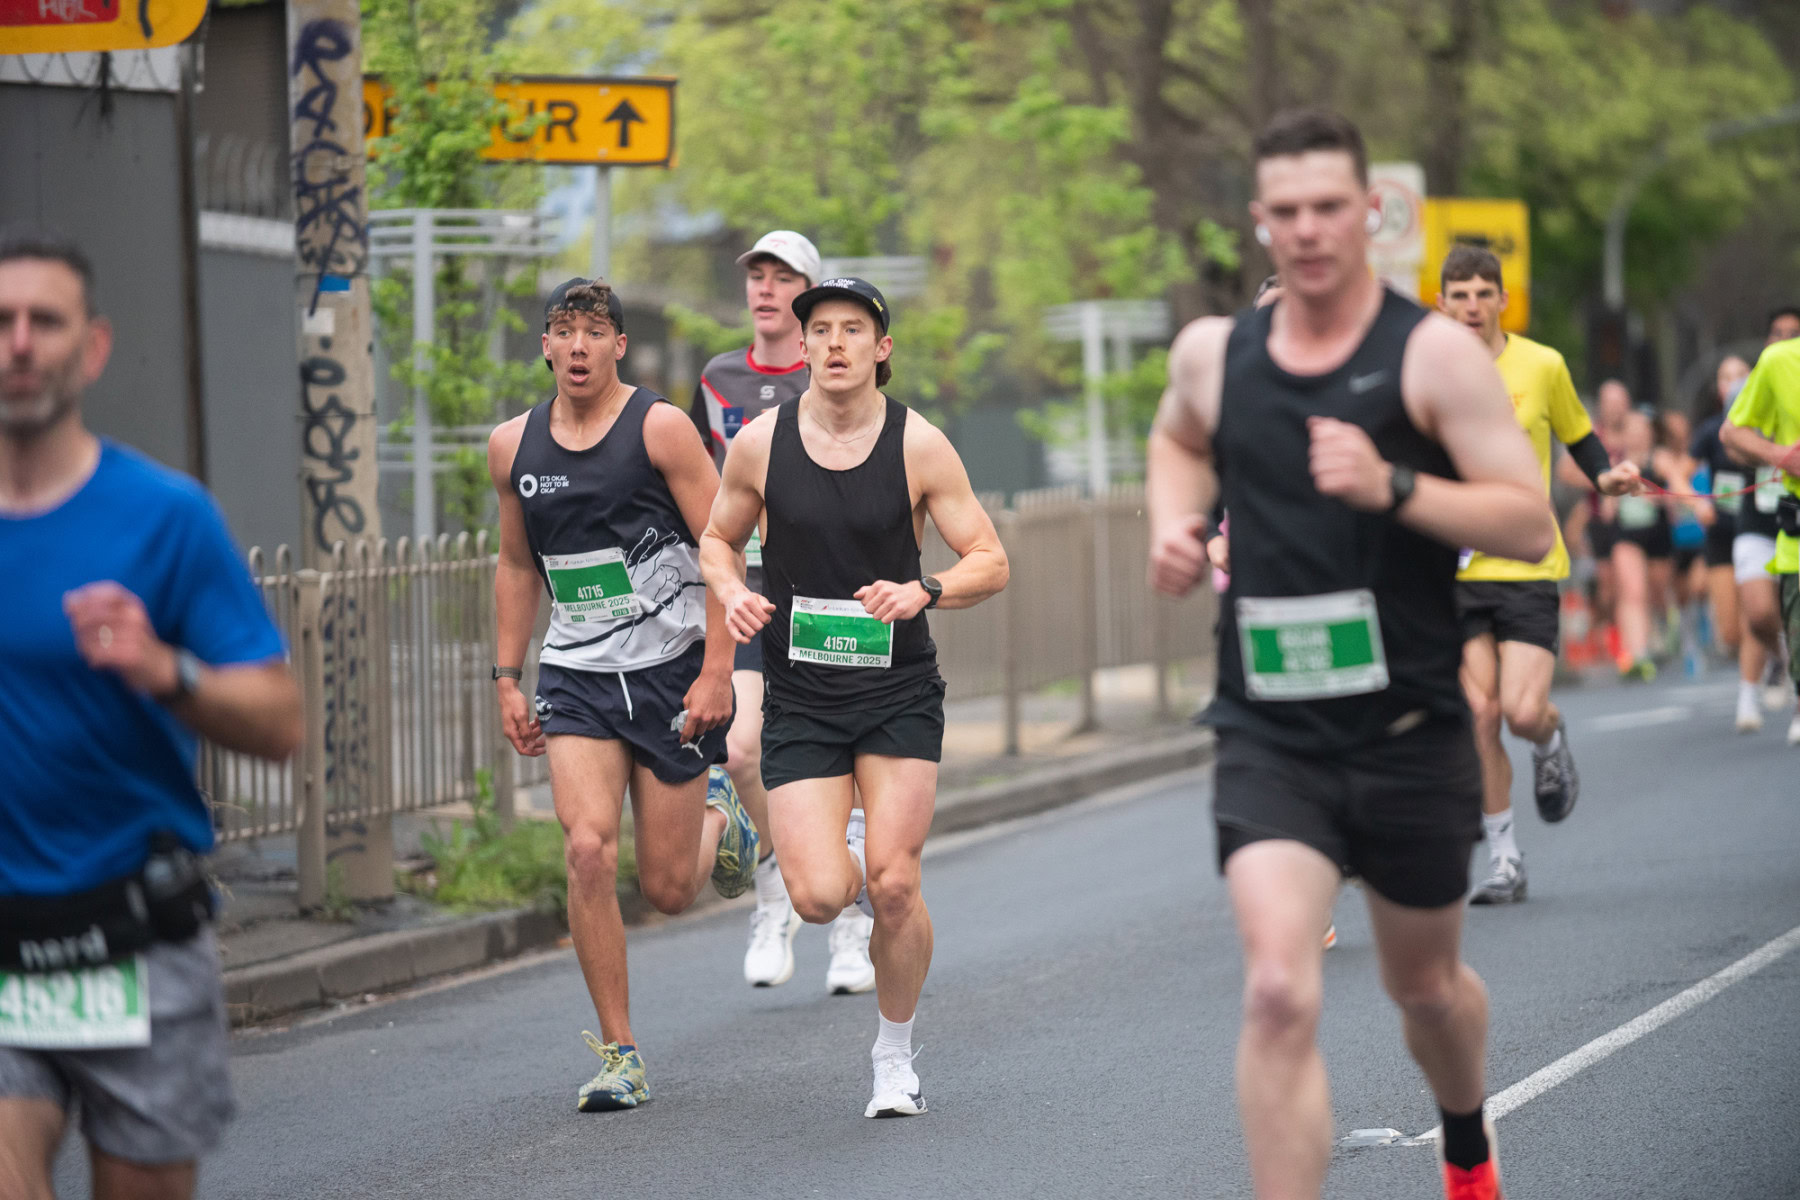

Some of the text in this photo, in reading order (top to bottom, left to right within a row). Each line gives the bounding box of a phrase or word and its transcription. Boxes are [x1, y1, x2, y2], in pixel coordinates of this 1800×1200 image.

[577, 584, 604, 600] 41715
[563, 596, 630, 613] MELBOURNE 2025
[823, 635, 857, 652] 41570
[799, 650, 881, 665] MELBOURNE 2025
